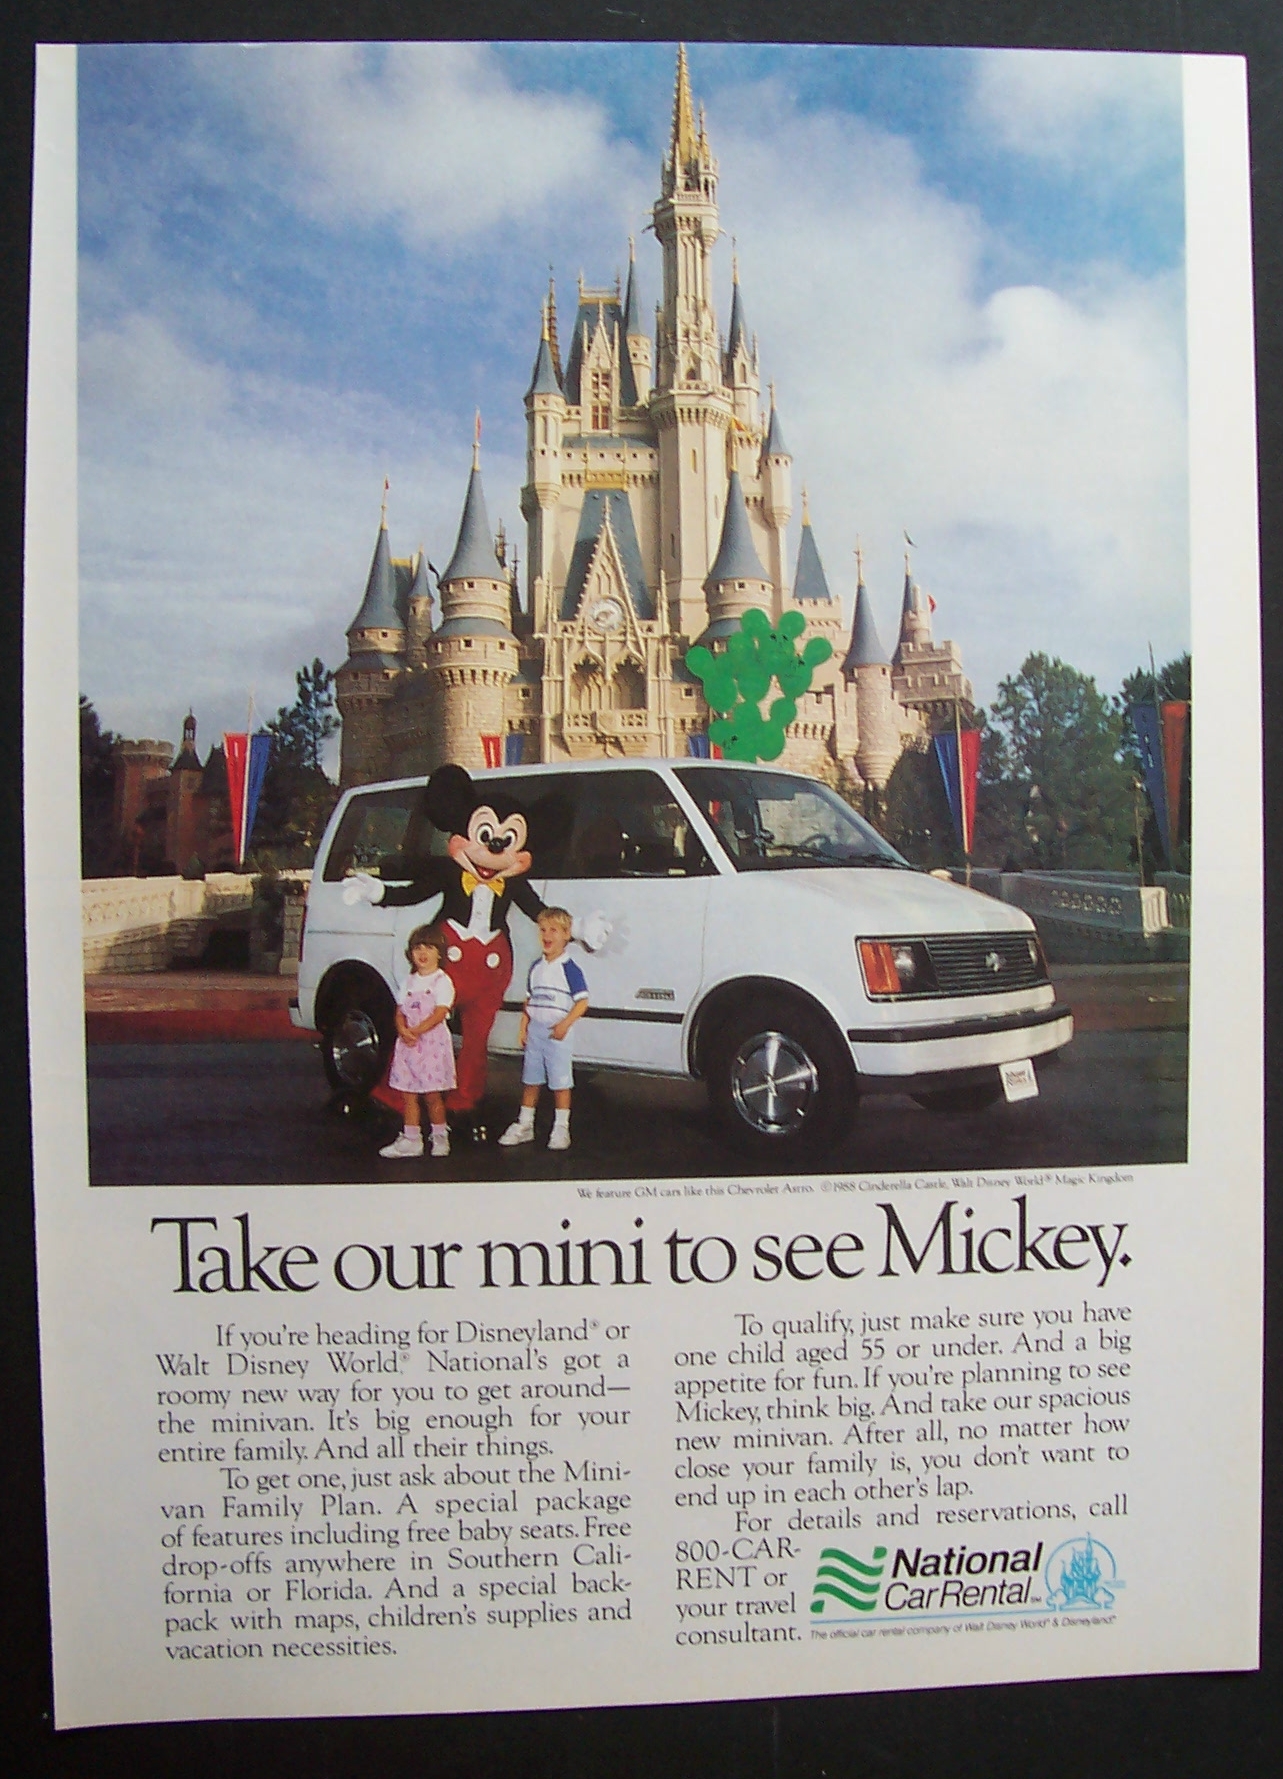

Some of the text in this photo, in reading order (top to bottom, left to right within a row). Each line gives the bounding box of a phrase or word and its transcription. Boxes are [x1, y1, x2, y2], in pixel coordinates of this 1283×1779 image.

[150, 1193, 1133, 1294] Take our mini to see Mickey.
[216, 1323, 236, 1347] If
[239, 1323, 310, 1352] you're
[315, 1321, 411, 1351] heading
[417, 1320, 450, 1345] for
[605, 1325, 631, 1341] or
[734, 1300, 1133, 1340] To qualify, just make sure you have
[155, 1352, 210, 1377] Walt
[226, 1352, 310, 1380] Disney
[426, 1347, 548, 1373] National's
[563, 1353, 602, 1376] got
[617, 1353, 630, 1369] a
[674, 1327, 1132, 1369] one child aged 55 or under. And a big
[158, 1403, 631, 1437] the minivan. It's big enough for your
[675, 1385, 1131, 1426] Mickey, think big. And take our spacious
[675, 1411, 1131, 1451] new minivan. After all, no matter how
[158, 1434, 554, 1465] entire family. And all their things.
[219, 1459, 631, 1495] To get one, just ask about the Mini-
[674, 1473, 974, 1512] end up in each other's lap.
[160, 1487, 632, 1522] van Family Plan. A special package
[734, 1493, 1128, 1533] For details and reservations, call
[161, 1515, 632, 1550] of features including free baby seats. Free
[675, 1536, 801, 1563] 800-CAR-
[162, 1542, 632, 1581] drop-offs anywhere in Southern Cali-
[892, 1541, 1043, 1578] National
[163, 1570, 632, 1605] fornia or Florida. And a special back-
[676, 1565, 789, 1591] RENT or
[165, 1597, 632, 1638] pack with maps, children's supplies and
[675, 1591, 797, 1624] your travel
[165, 1635, 397, 1660] vacation necessities.
[675, 1620, 802, 1646] consultant.
